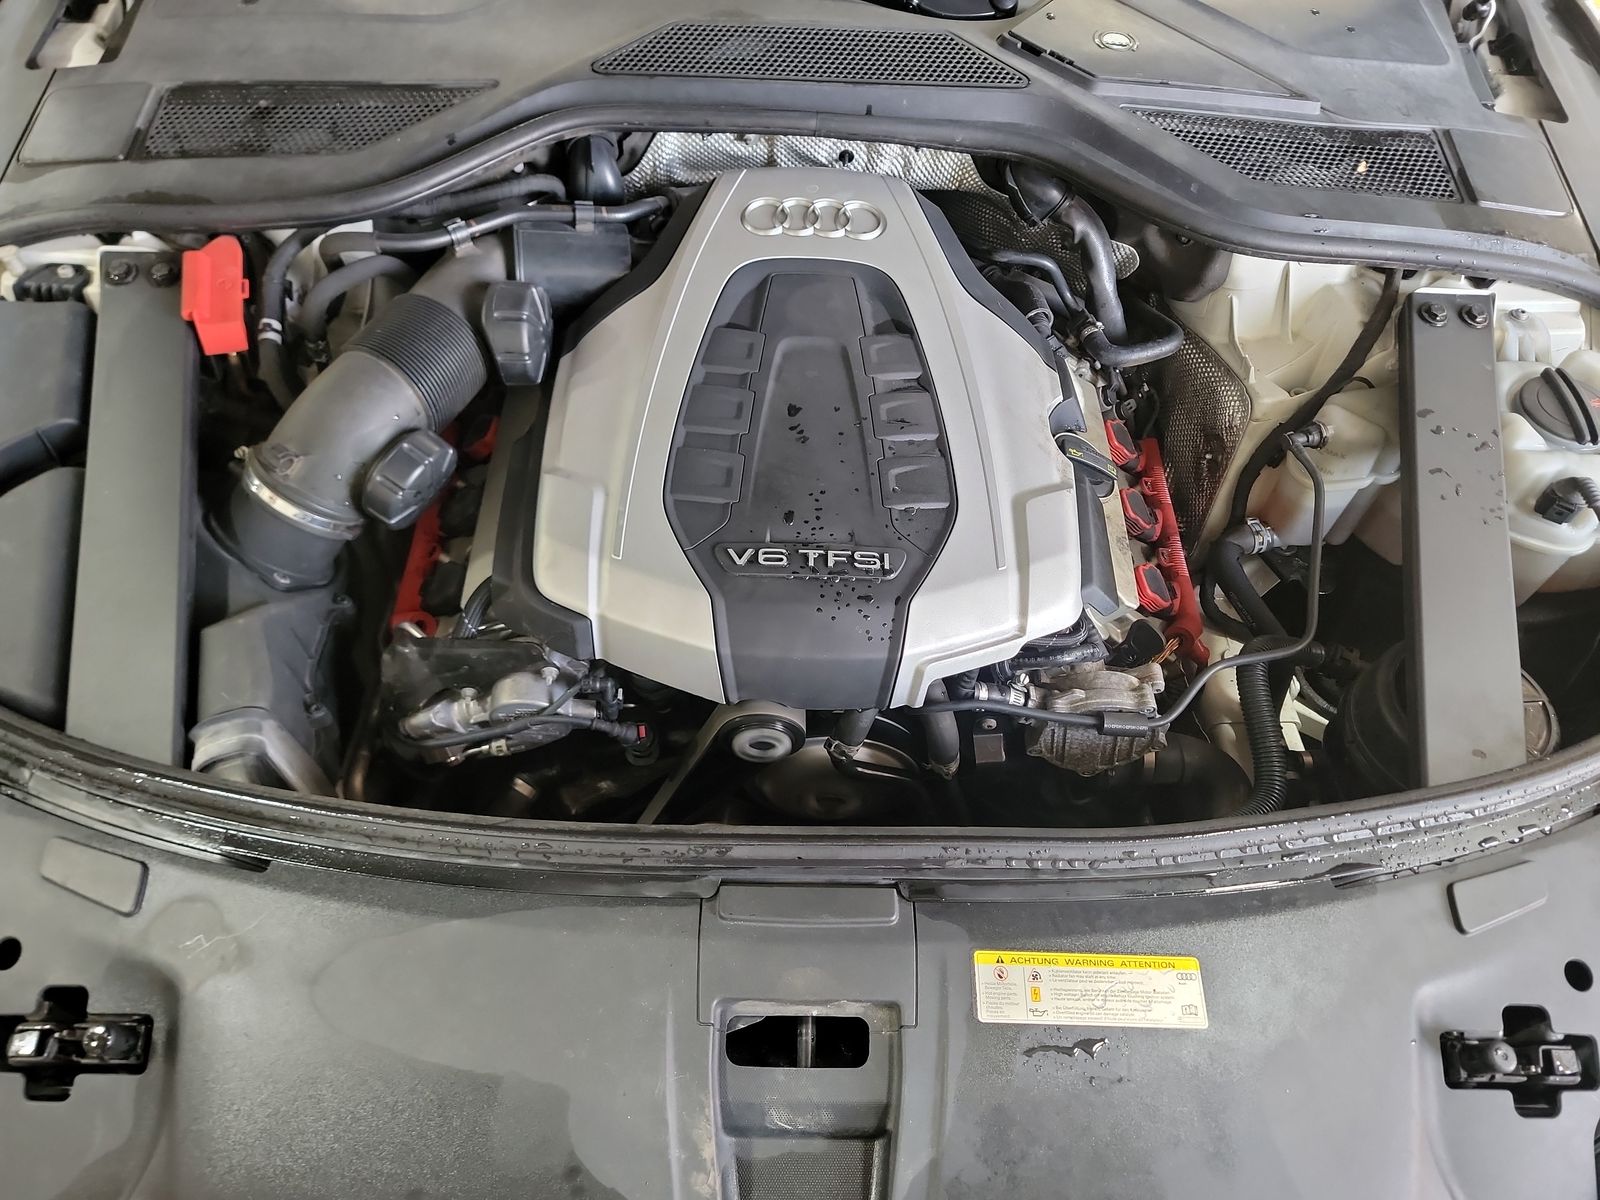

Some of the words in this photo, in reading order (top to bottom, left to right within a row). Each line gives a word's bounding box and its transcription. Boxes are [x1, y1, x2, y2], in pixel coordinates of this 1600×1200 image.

[727, 547, 789, 567] V6
[798, 549, 890, 570] TFSI
[1009, 956, 1059, 965] ACHTUNG
[1064, 958, 1115, 967] WARNING
[1119, 960, 1176, 969] ATTENTION
